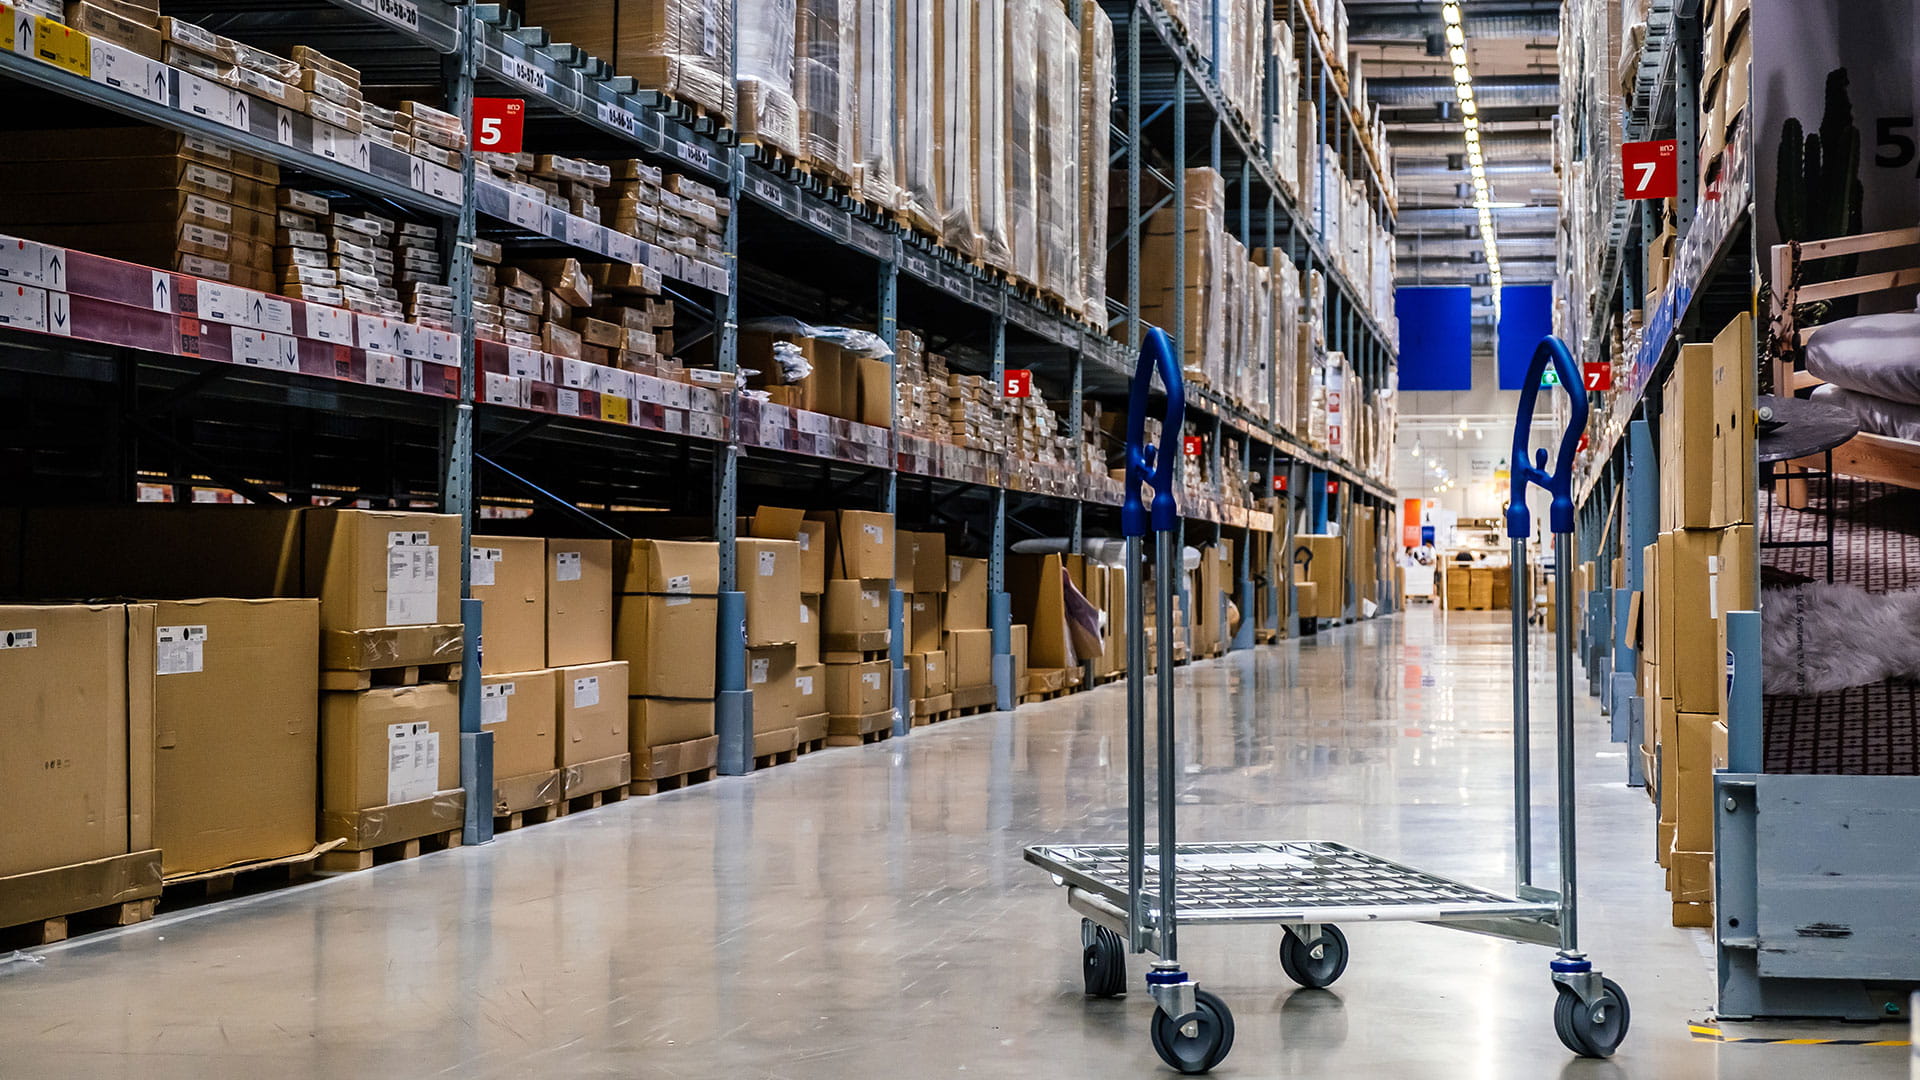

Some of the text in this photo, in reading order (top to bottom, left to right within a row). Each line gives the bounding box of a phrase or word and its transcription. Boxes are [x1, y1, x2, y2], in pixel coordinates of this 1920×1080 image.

[480, 117, 502, 145] 5
[1633, 162, 1656, 191] 7
[1008, 379, 1020, 394] 5
[1588, 372, 1601, 388] 7
[1186, 442, 1195, 453] 5
[1796, 594, 1804, 614] IKEA
